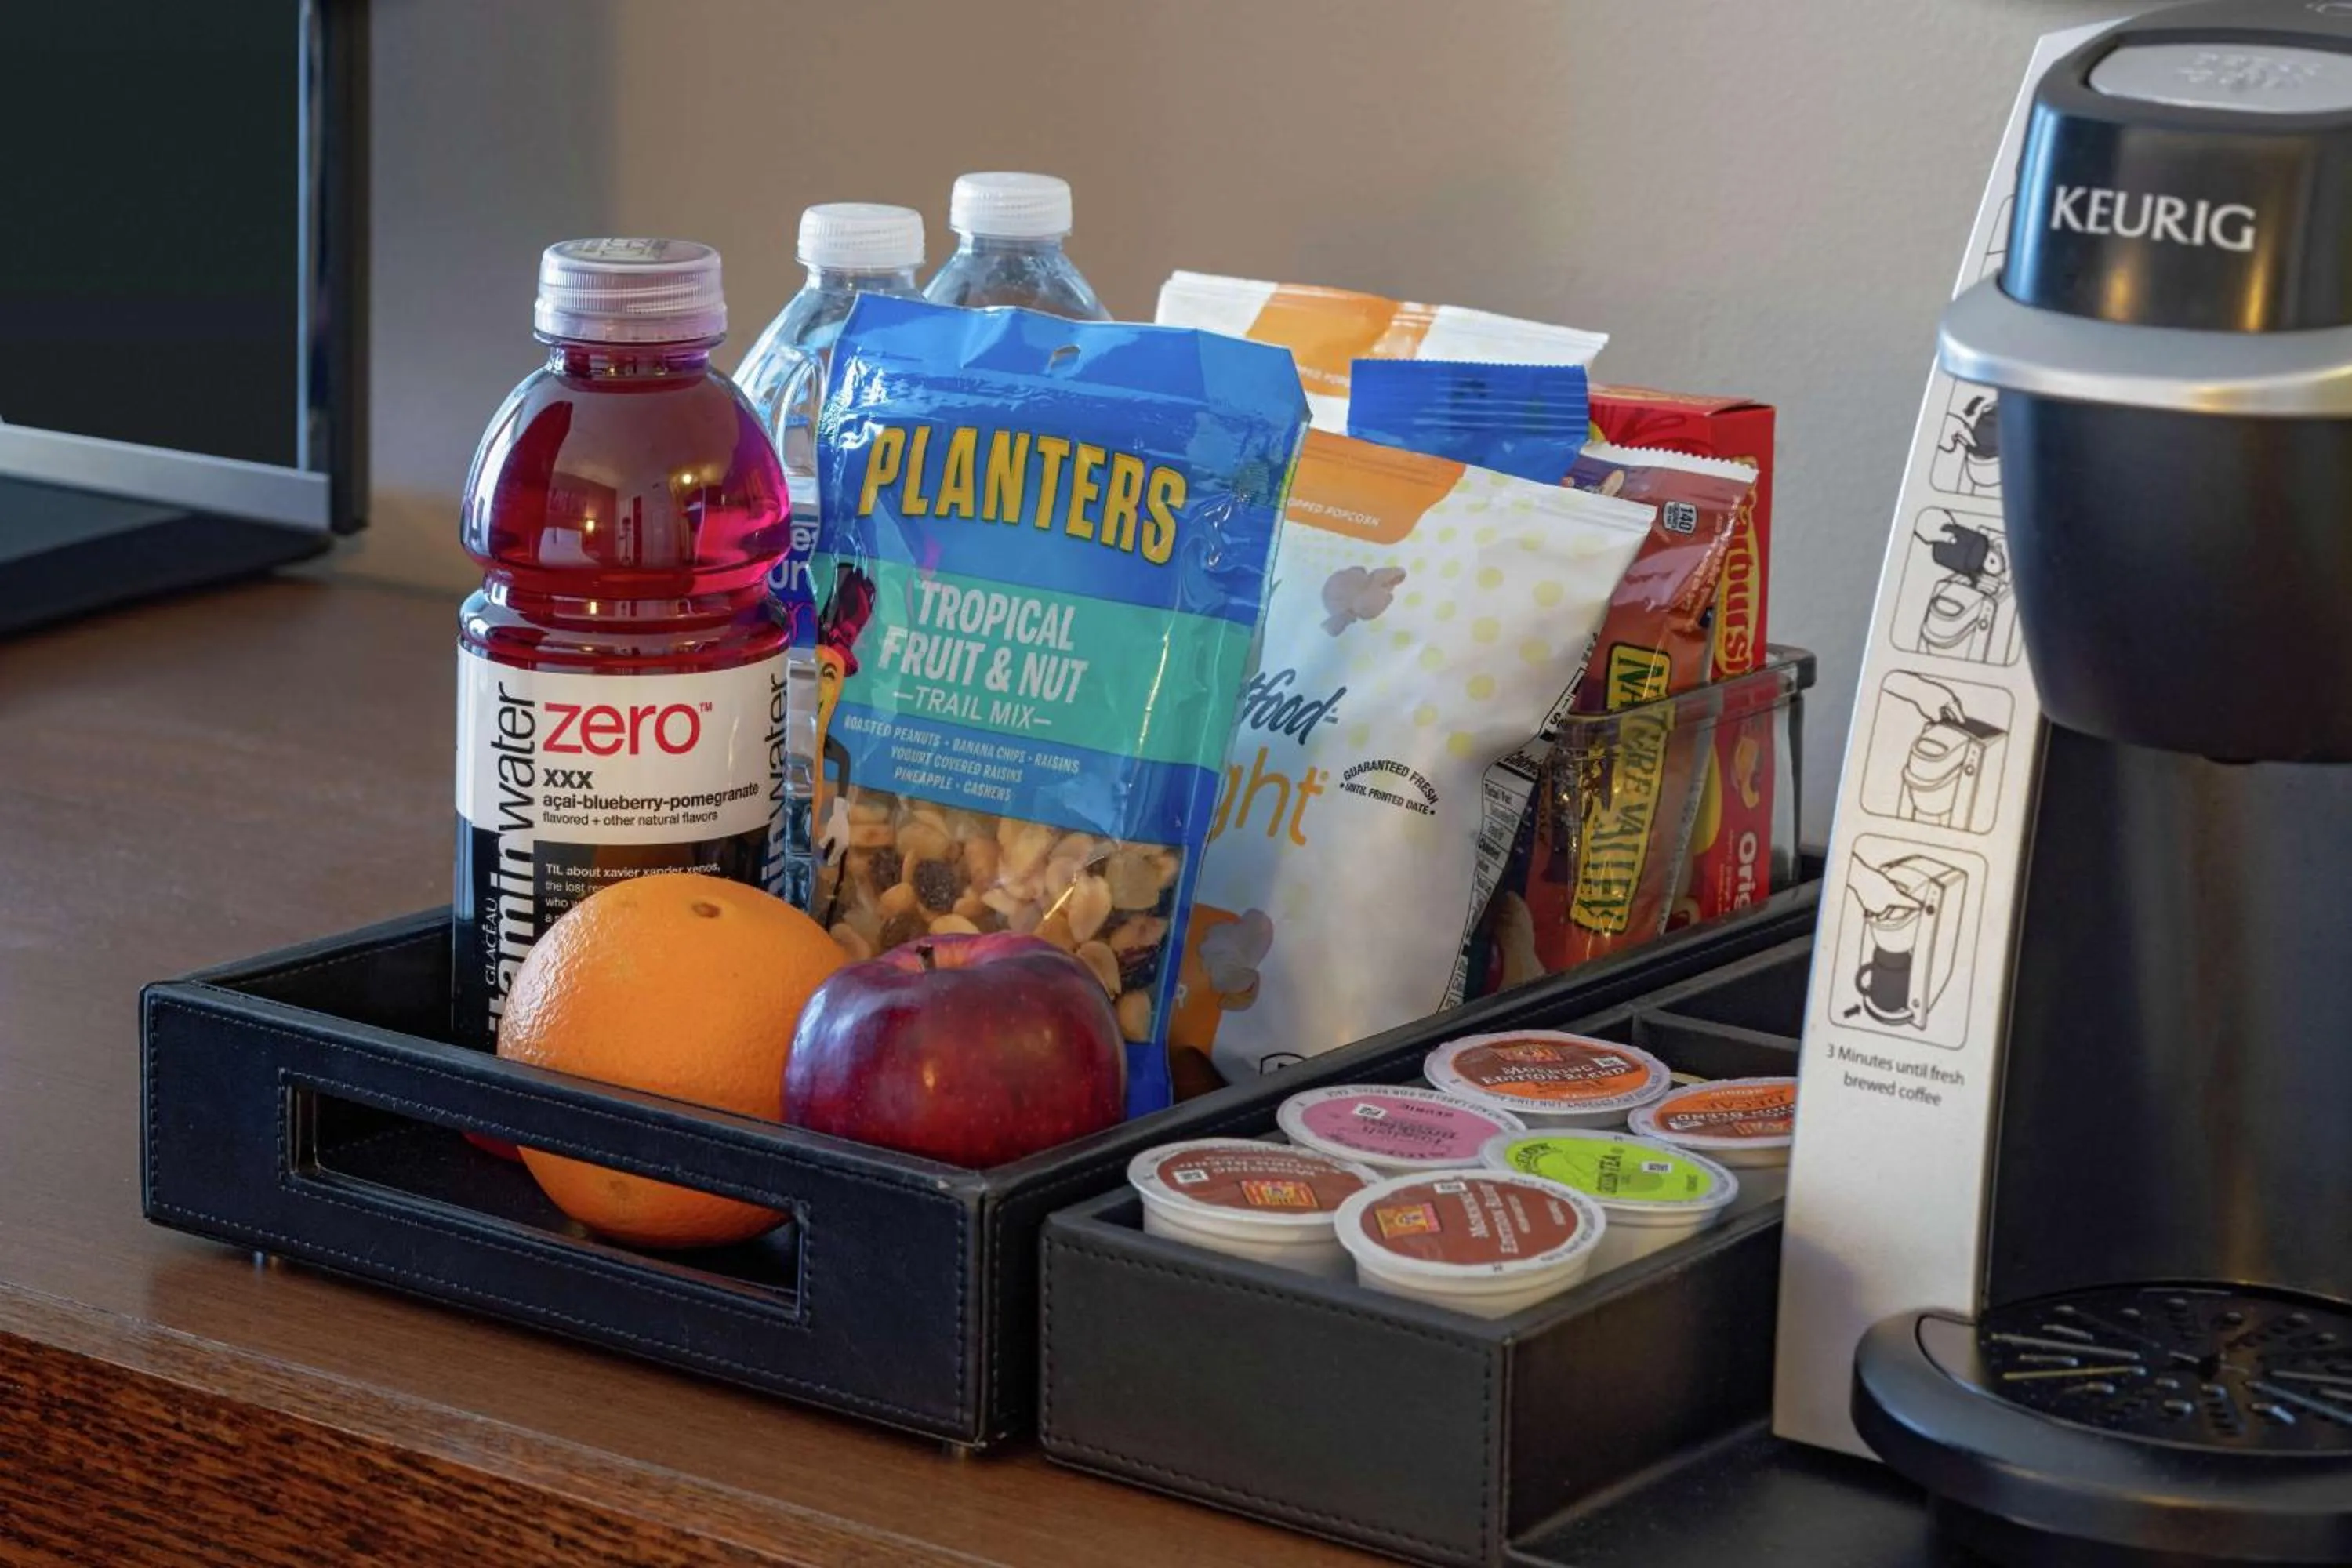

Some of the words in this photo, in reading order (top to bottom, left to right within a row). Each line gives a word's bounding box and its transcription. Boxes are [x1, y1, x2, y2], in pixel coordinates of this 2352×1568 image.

[2049, 183, 2256, 252] KEURIG
[857, 426, 1188, 565] PLANTERS
[1287, 498, 1326, 514] OPPED
[1325, 505, 1381, 528] POPCORN
[1679, 507, 1694, 532] 140
[918, 580, 1076, 651] TROPICAL
[877, 625, 985, 686] FRUIT
[985, 647, 1012, 692] &
[1018, 652, 1090, 704] NUT
[844, 713, 892, 736] ROASTED
[893, 722, 942, 746] PEANUTS
[952, 738, 995, 759] BANANA
[996, 744, 1027, 764] CHIPS
[1034, 752, 1080, 775] RAISINS
[543, 768, 594, 789] xxx
[891, 745, 932, 765] YOGURT
[934, 754, 982, 775] COVERED
[984, 764, 1023, 783] RAISINS
[1343, 759, 1411, 781] GUARANTEED
[1410, 771, 1439, 806] FRESH
[543, 782, 760, 811] açai-blueberry-pomegranate
[894, 765, 953, 791] PINEAPPLE
[963, 780, 1012, 802] CASHEWS
[1345, 782, 1367, 797] UNTIL
[1368, 788, 1404, 807] PRINTED
[1406, 797, 1430, 816] DATE
[543, 811, 589, 825] flavored
[603, 813, 636, 826] other
[638, 812, 680, 826] natural
[682, 810, 719, 824] flavors
[544, 863, 564, 877] TIL
[566, 865, 601, 878] about
[602, 865, 640, 879] xavier
[545, 881, 563, 892] the
[565, 881, 586, 895] lost
[545, 896, 568, 908] who
[1826, 1044, 1835, 1058] 3
[1838, 1046, 1893, 1072] Minutes
[1896, 1062, 1928, 1079] until
[1930, 1065, 1965, 1087] fresh
[1843, 1071, 1896, 1097] brewed
[1898, 1085, 1944, 1108] coffee
